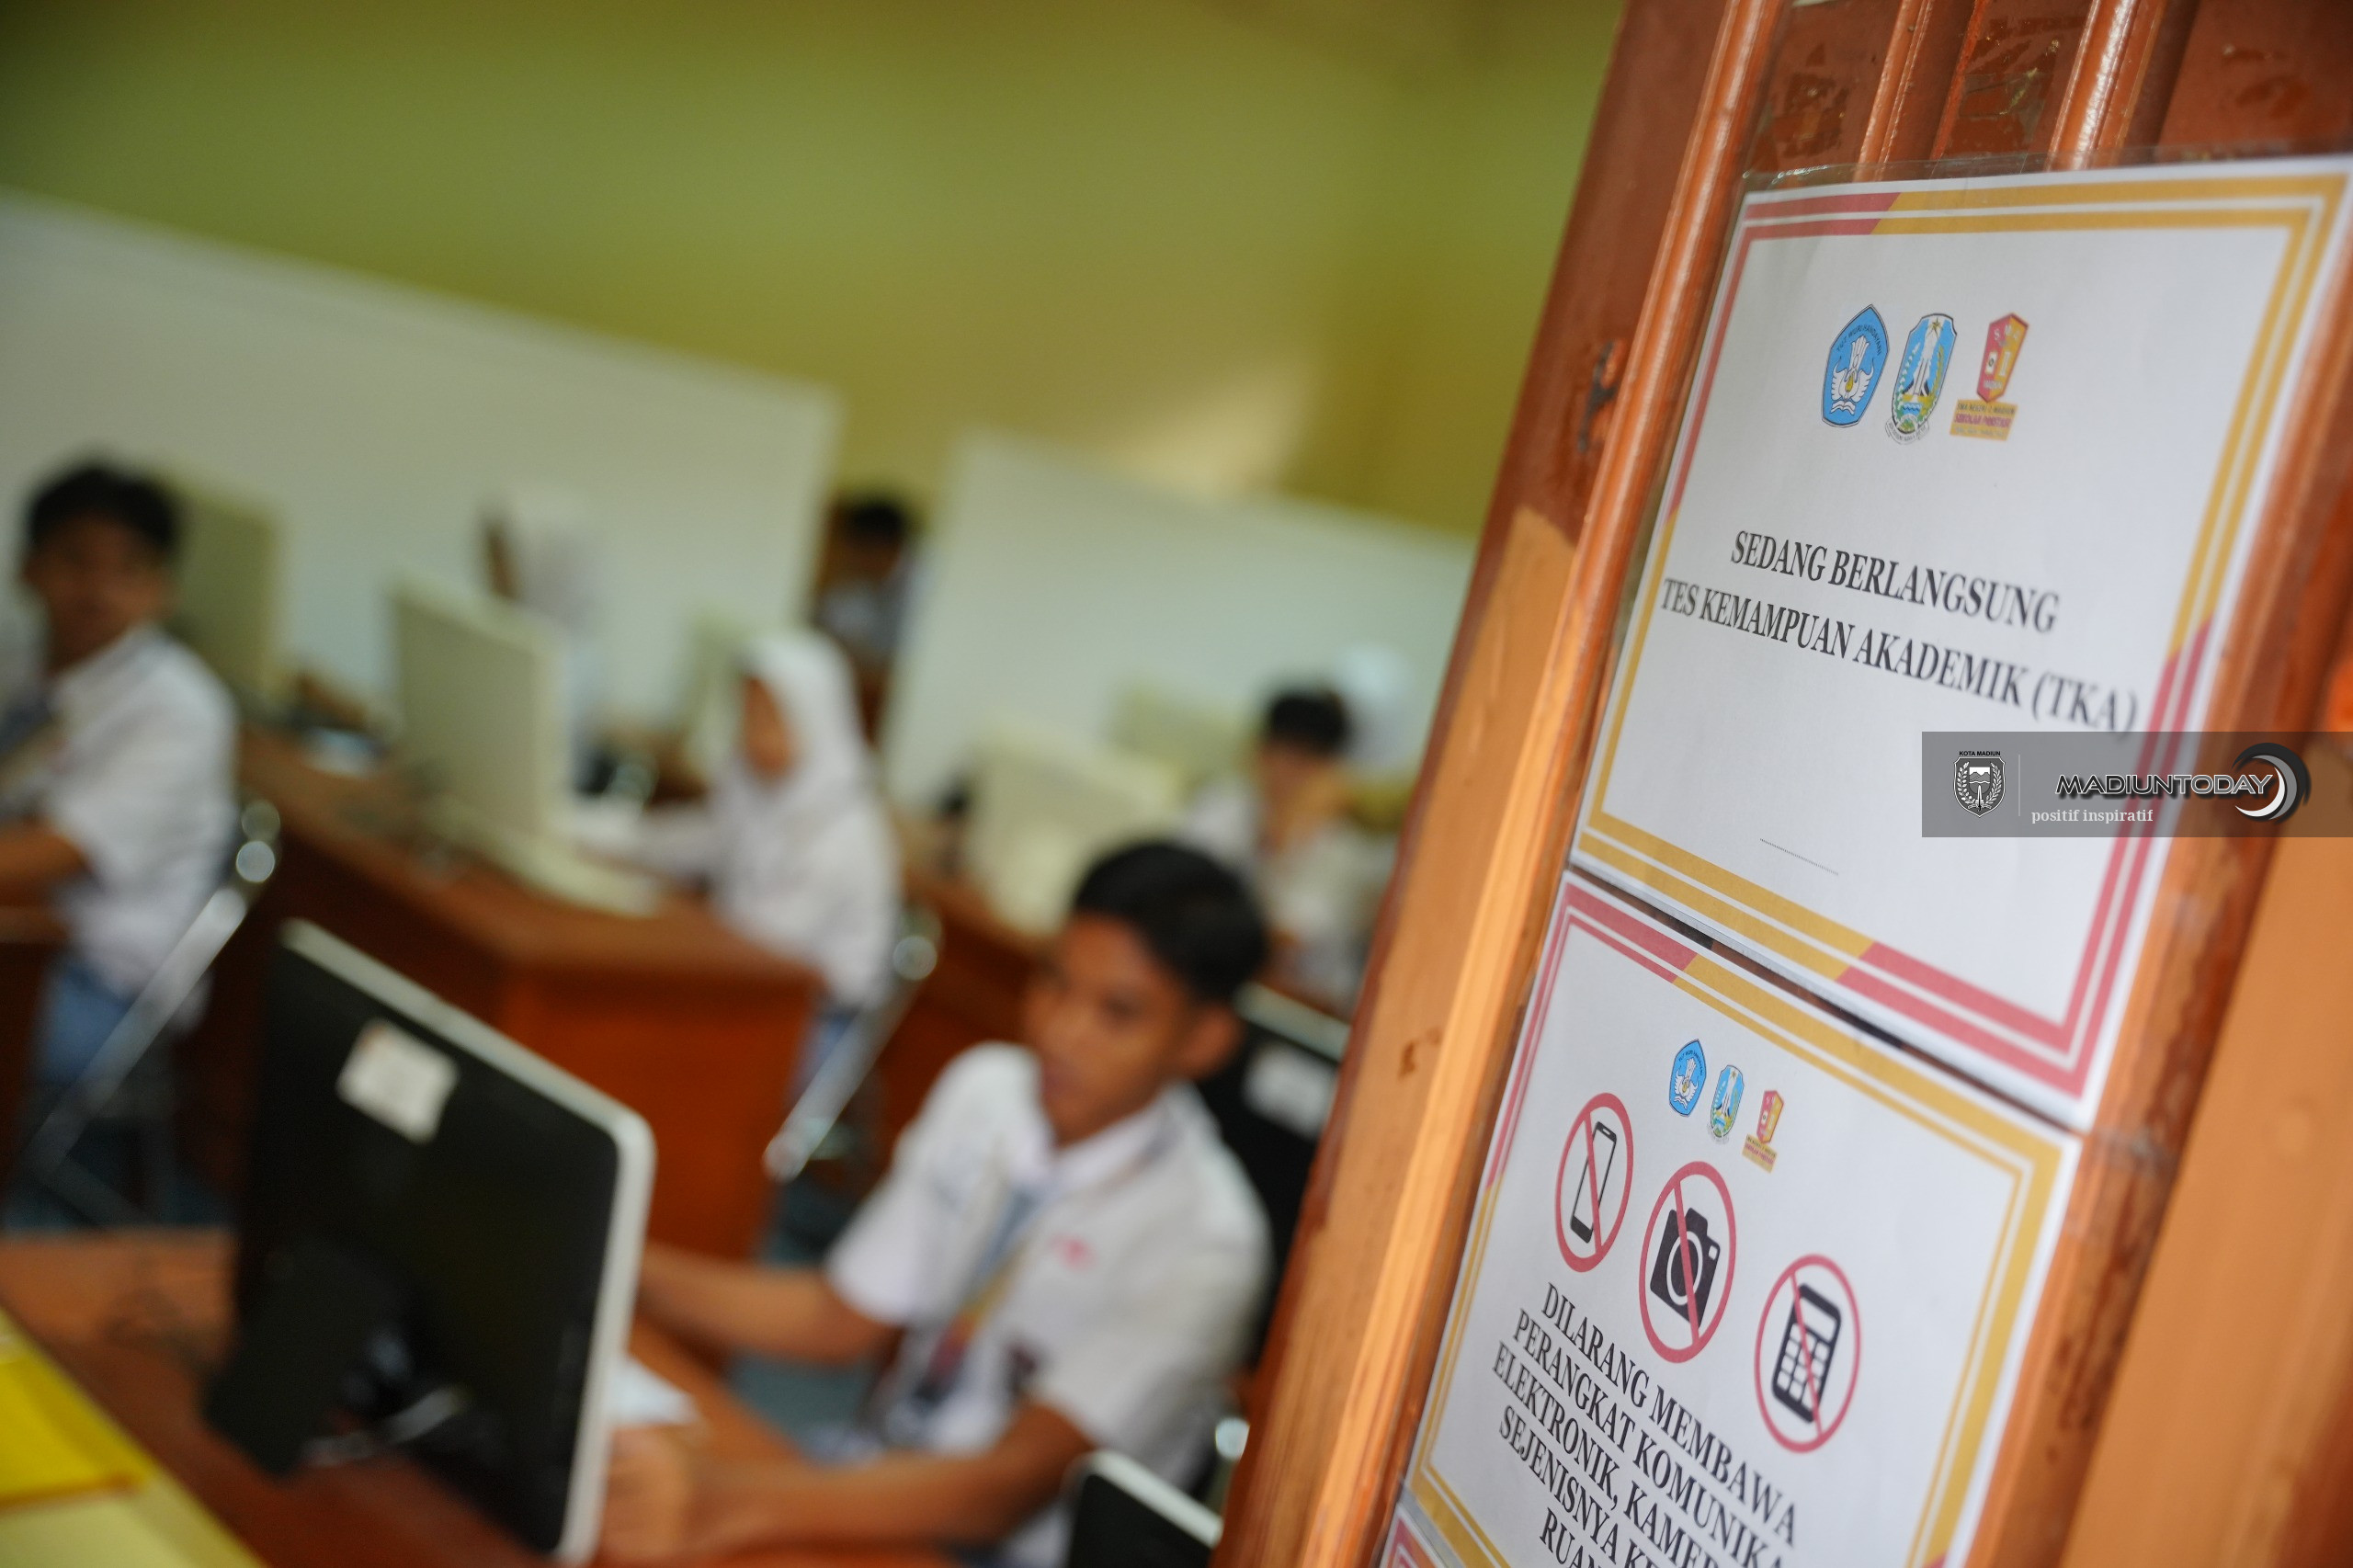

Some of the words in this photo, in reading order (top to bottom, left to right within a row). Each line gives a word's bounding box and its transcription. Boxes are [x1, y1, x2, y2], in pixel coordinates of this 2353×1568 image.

[1660, 577, 1698, 617] TES
[1699, 588, 1856, 659] KEMAMPUAN
[1852, 629, 2030, 707] AKADEMIK
[2031, 671, 2140, 741] (TKA)
[1731, 530, 1827, 581] SEDANG
[1828, 550, 2061, 634] BERLANGSUNG
[1492, 1340, 1620, 1511] ELEKTRONIK,
[1499, 1404, 1619, 1565] SEJENISNYA
[1513, 1308, 1636, 1453] PERANGKAT
[1632, 1428, 1782, 1568] KOMUNIK
[1541, 1282, 1650, 1408] DILARANG
[1649, 1385, 1795, 1548] MEMBAWA
